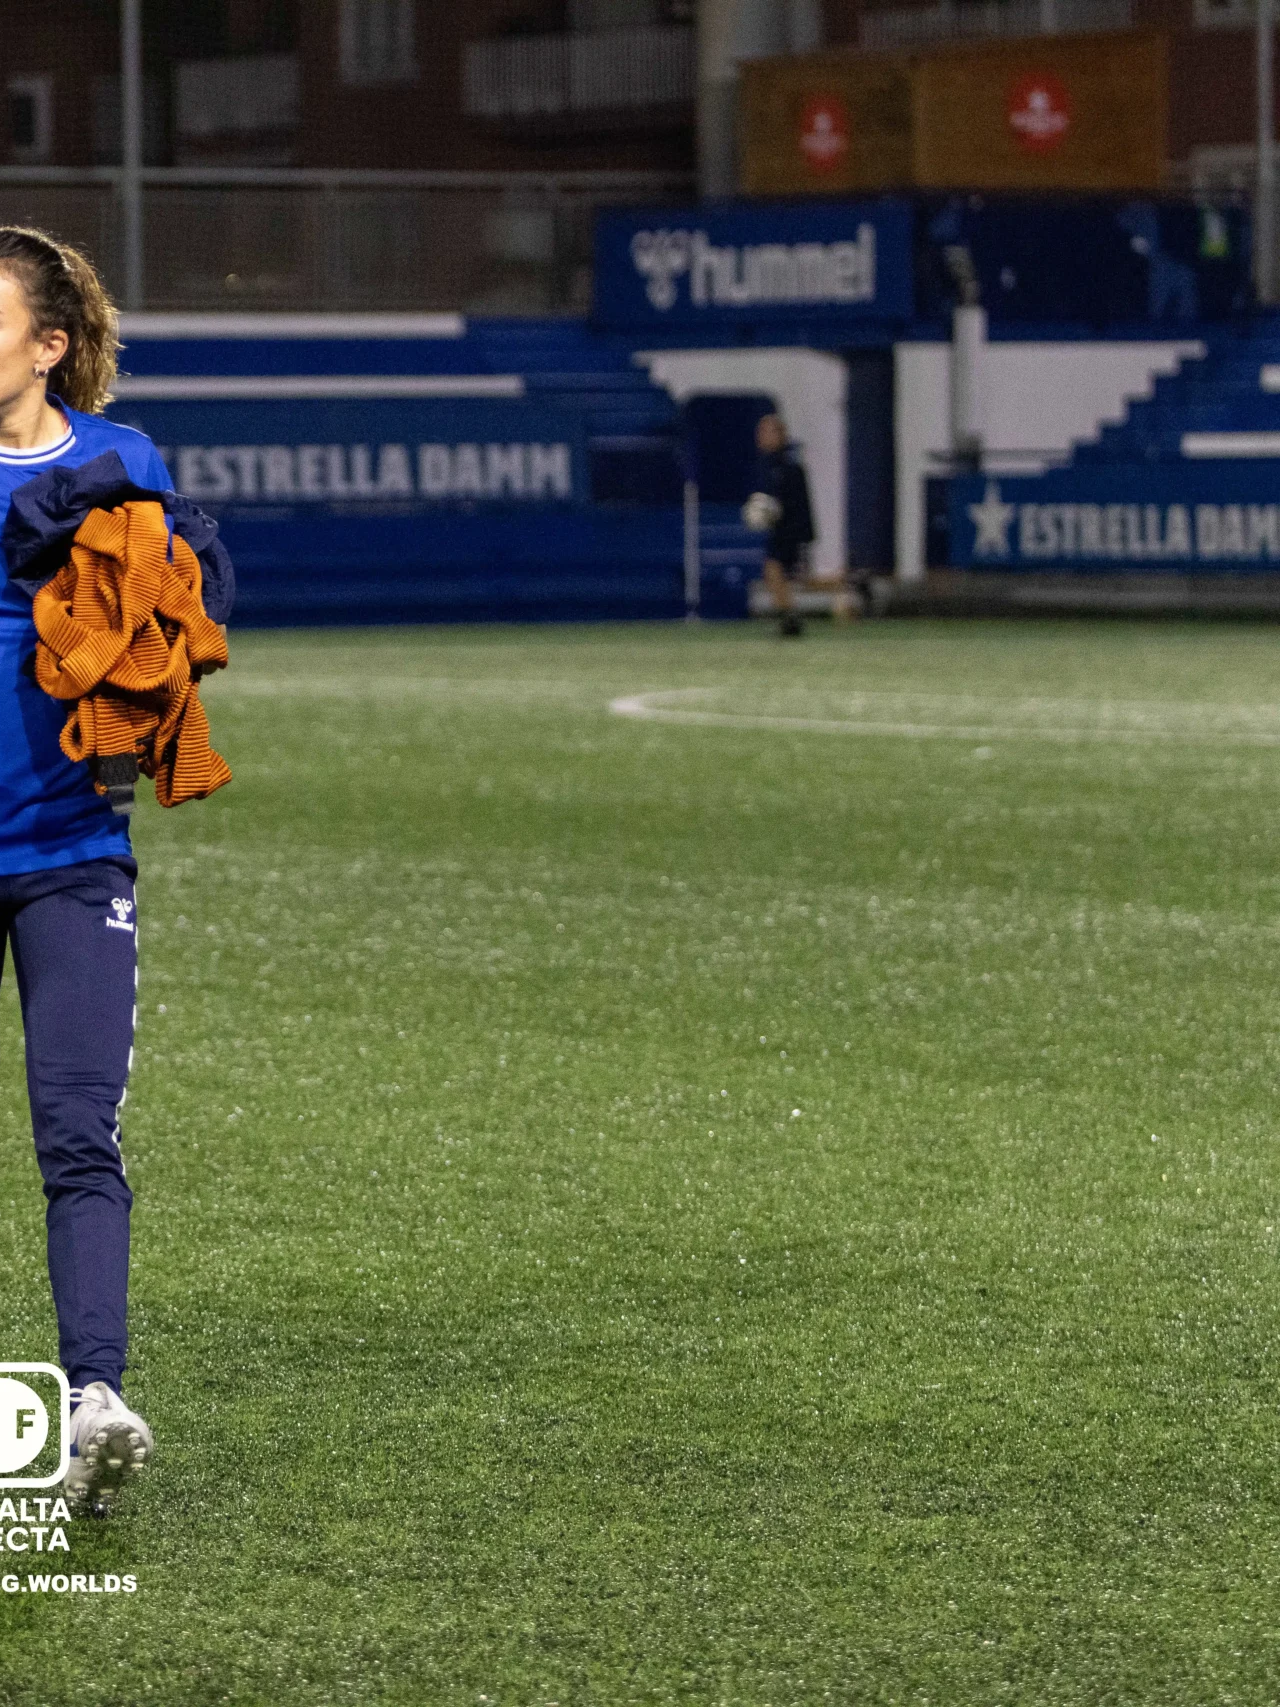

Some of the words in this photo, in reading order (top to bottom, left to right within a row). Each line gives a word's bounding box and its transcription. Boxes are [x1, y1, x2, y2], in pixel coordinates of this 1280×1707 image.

[691, 222, 876, 307] hummel
[177, 444, 414, 498] ESTRELLA
[419, 443, 571, 498] DAMM
[1019, 502, 1193, 557] ESTRELLA
[1194, 502, 1280, 558] DAM
